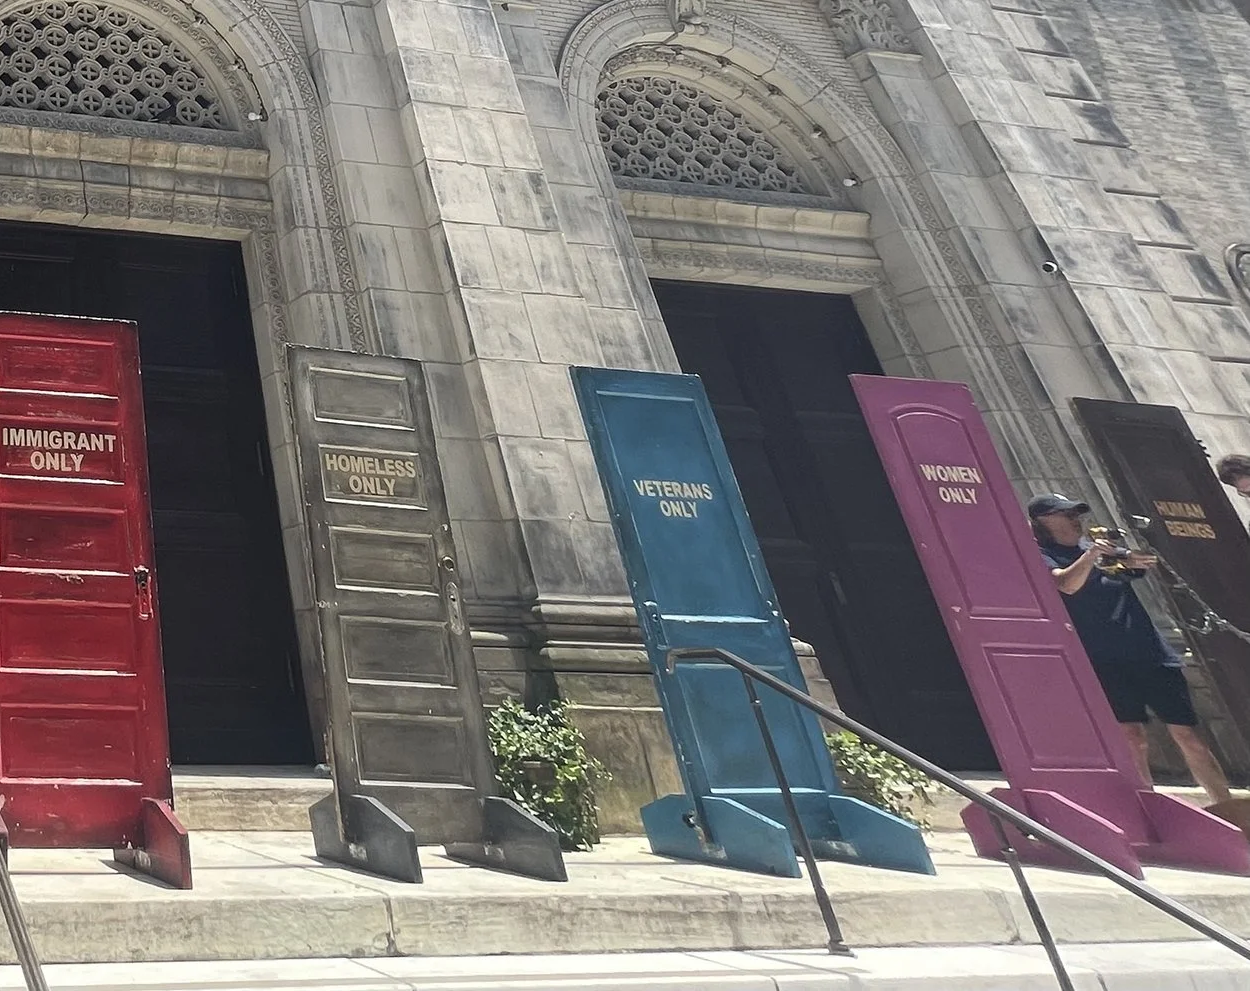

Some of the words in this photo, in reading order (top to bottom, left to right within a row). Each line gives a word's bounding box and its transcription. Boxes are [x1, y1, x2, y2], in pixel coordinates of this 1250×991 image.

[2, 427, 117, 453] IMMIGRANT
[30, 450, 84, 472] ONLY
[324, 453, 416, 478] HOMELESS
[919, 464, 982, 484] WOMEN
[348, 475, 396, 496] ONLY
[632, 479, 713, 501] VETERANS
[938, 486, 978, 505] ONLY
[659, 500, 699, 519] ONLY
[1152, 499, 1207, 519] HUMAN
[1164, 520, 1217, 540] BEINGS
